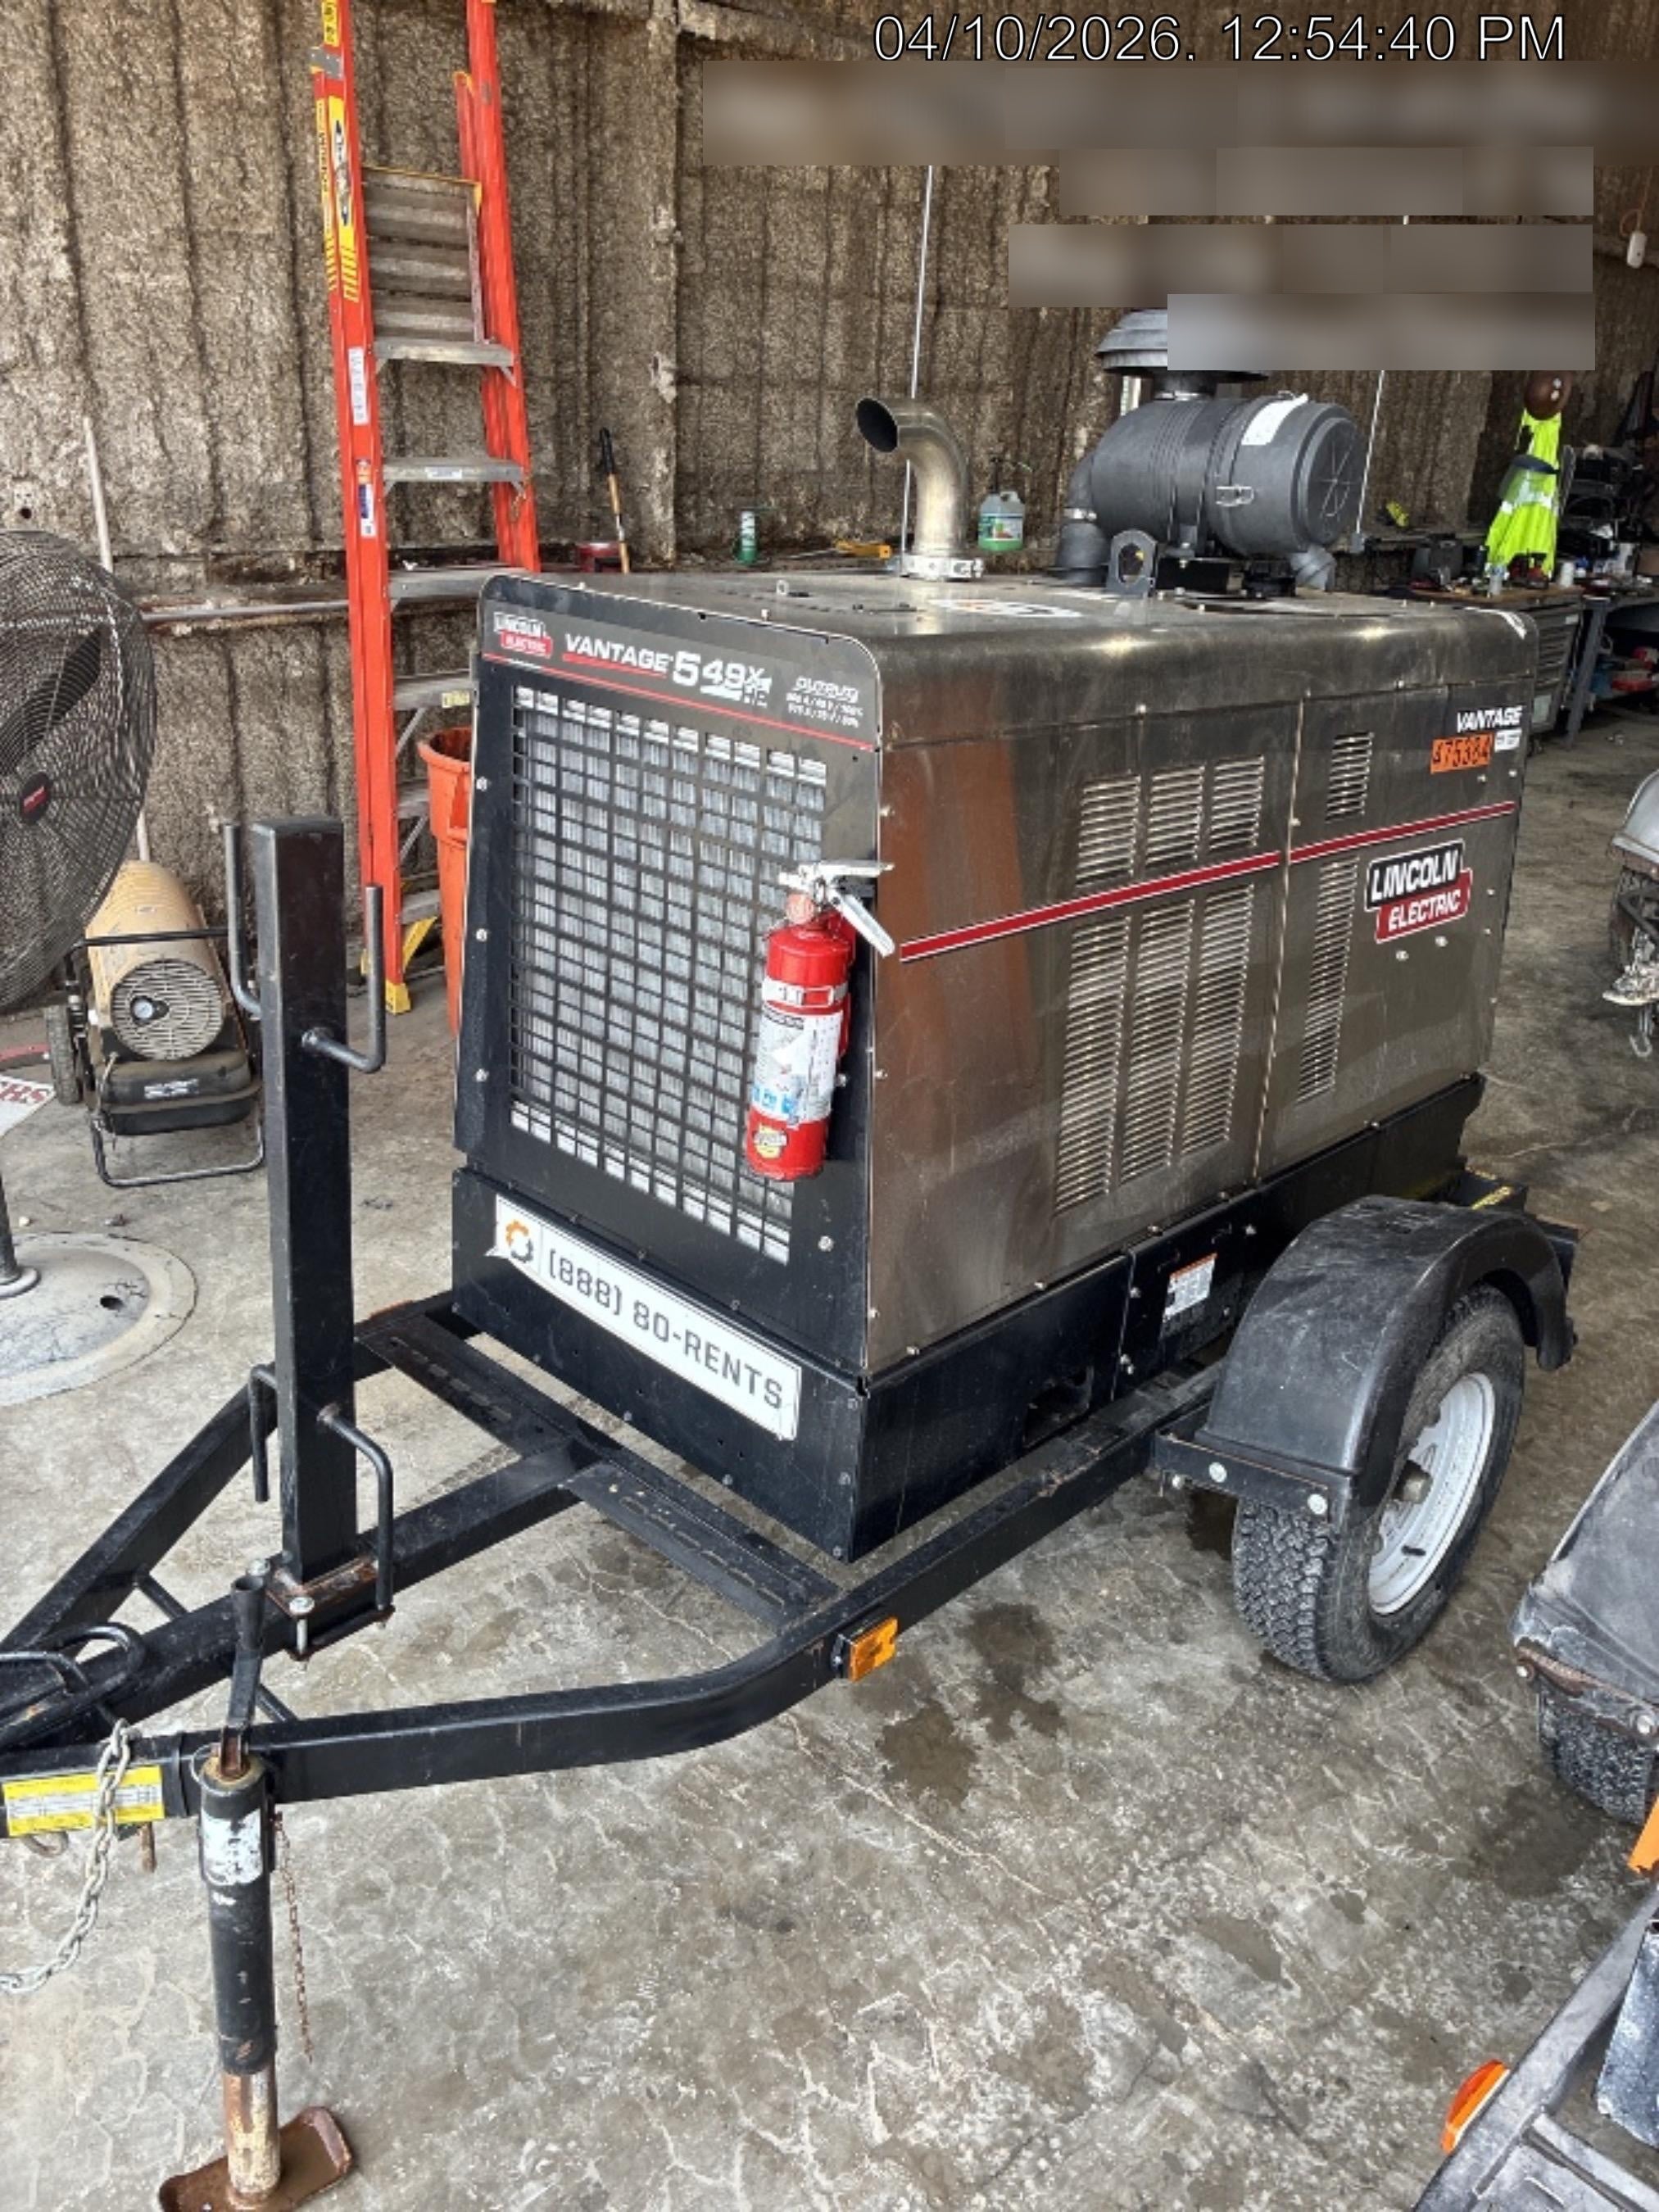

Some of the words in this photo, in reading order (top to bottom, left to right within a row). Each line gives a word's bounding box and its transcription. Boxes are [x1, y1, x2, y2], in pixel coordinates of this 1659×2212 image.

[564, 633, 668, 673] VANTAGE
[1457, 705, 1523, 733] VANTAGE
[1371, 850, 1458, 903] LINCOLN
[1388, 889, 1462, 932] ELECTRIC
[550, 1249, 623, 1316] (888)
[632, 1299, 782, 1410] 80-RENTS
